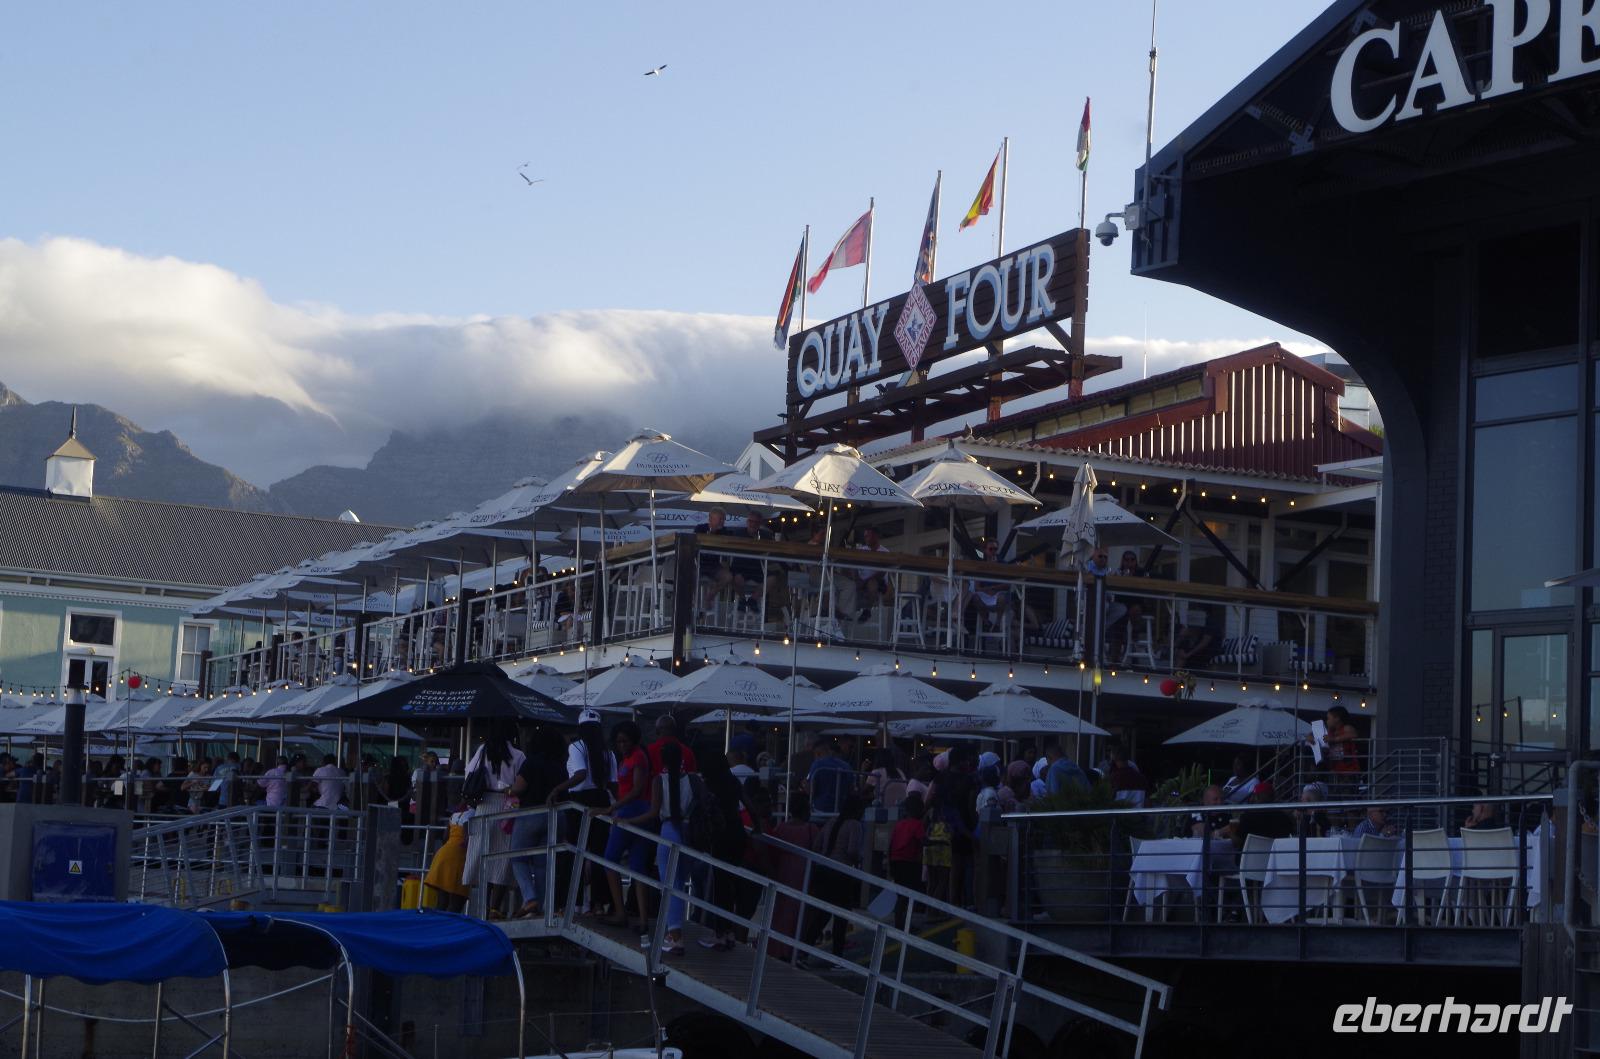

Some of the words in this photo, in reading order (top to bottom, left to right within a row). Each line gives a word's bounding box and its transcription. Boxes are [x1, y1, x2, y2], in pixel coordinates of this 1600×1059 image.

[796, 301, 890, 398] QUAY
[943, 244, 1057, 351] FOUR
[809, 479, 841, 494] QUAY
[860, 486, 897, 497] FOUR
[928, 481, 961, 491] QUAY
